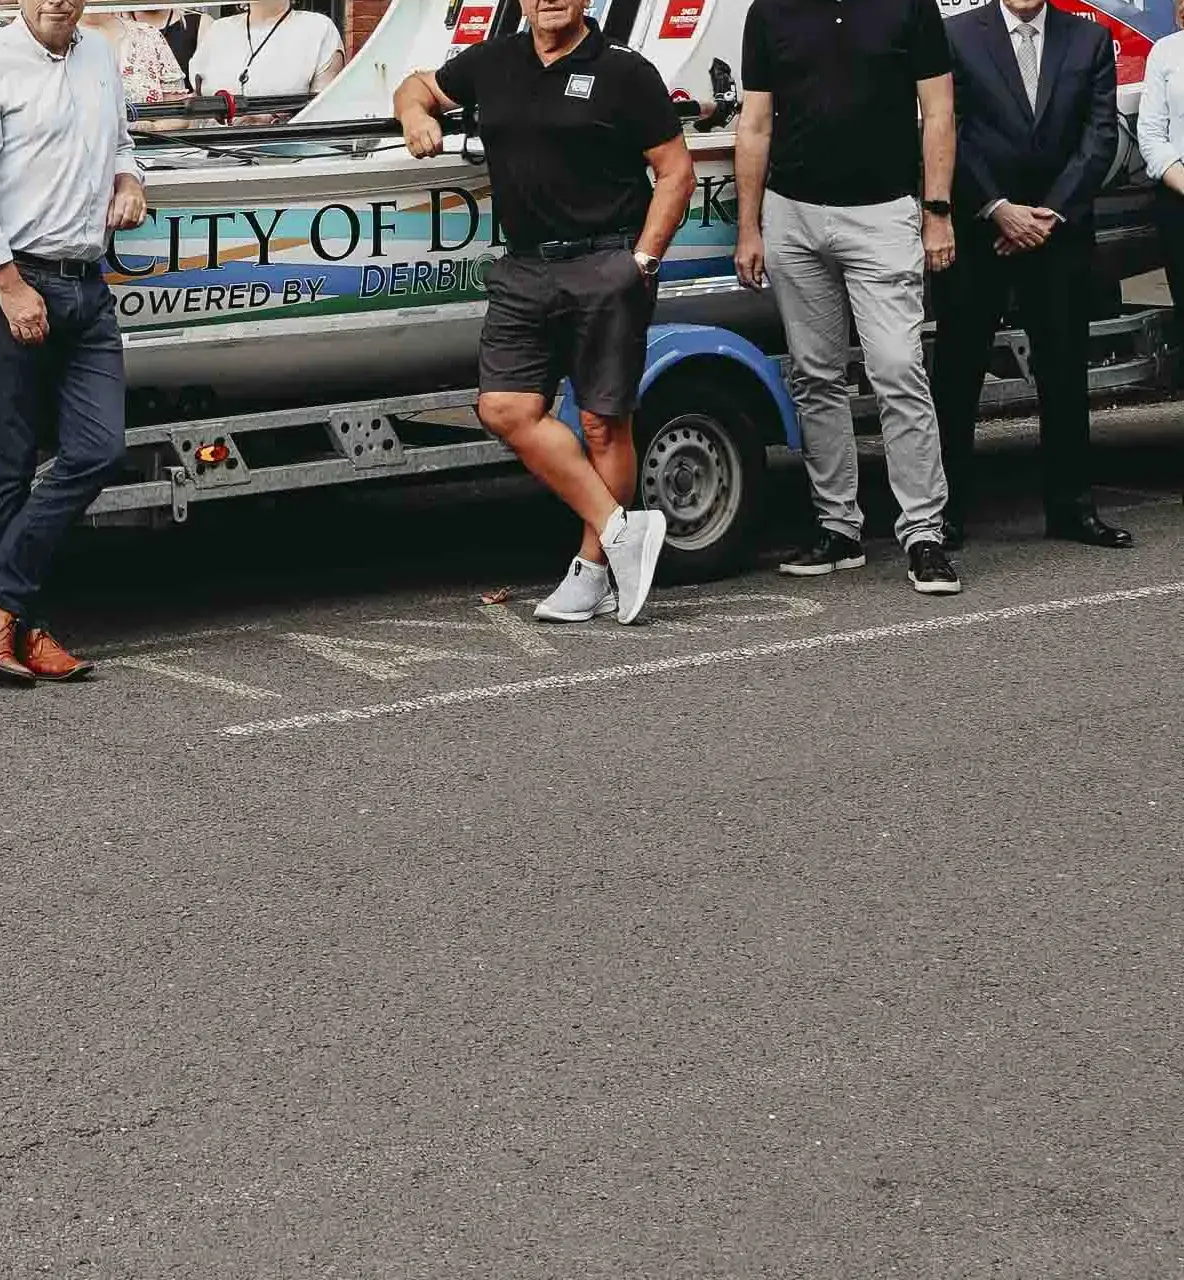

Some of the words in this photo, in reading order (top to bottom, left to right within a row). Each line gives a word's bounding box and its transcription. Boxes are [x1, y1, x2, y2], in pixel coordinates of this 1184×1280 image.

[105, 207, 289, 278] CITY
[310, 199, 398, 262] OF
[118, 280, 271, 317] OWERED
[282, 275, 328, 305] BY
[359, 253, 498, 299] DERBIO
